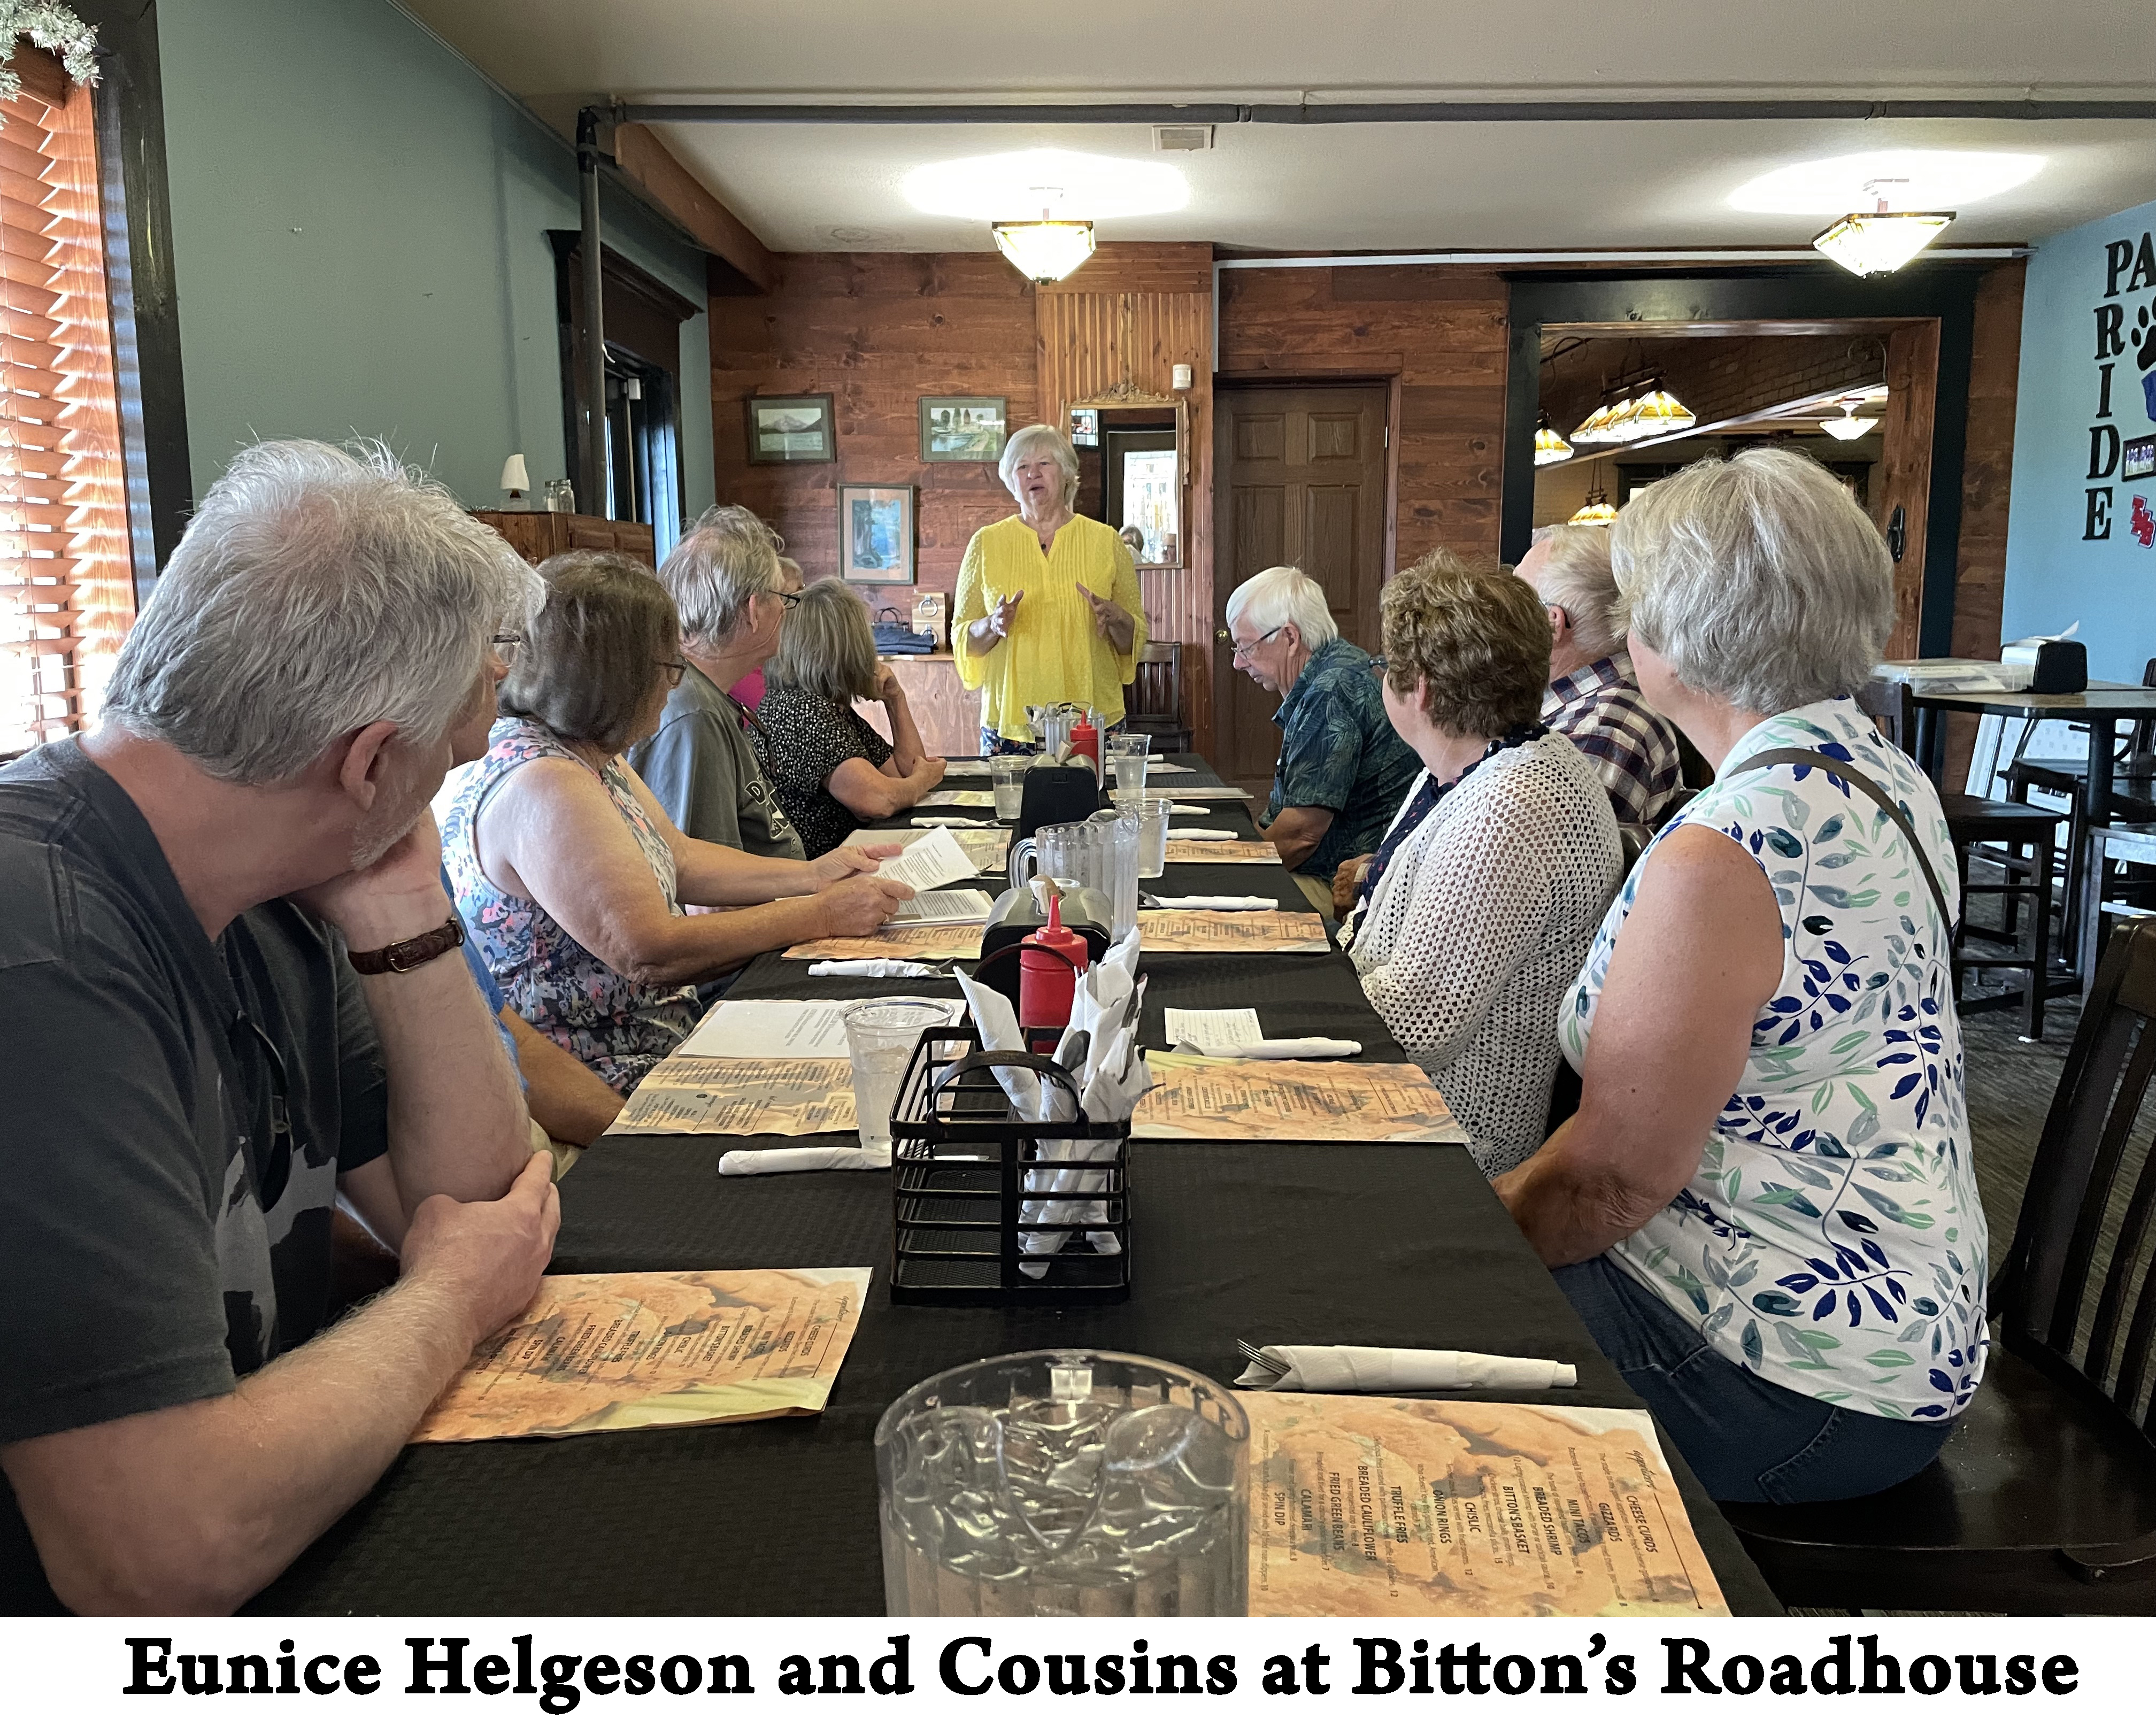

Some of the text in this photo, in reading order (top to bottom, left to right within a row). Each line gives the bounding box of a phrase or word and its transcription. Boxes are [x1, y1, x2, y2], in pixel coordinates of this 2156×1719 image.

[581, 1325, 596, 1339] FRIED
[602, 1319, 622, 1342] BREADED
[1274, 1492, 1285, 1525] SPIN DIP
[1300, 1489, 1313, 1531] CALAMARI
[1328, 1471, 1345, 1551] FRIED GREEN BEANS
[1358, 1466, 1377, 1561] BREADED CAULIFLOWER
[1390, 1486, 1408, 1544] TRUFFLE FRIES
[1433, 1490, 1452, 1544] ONION RINGS
[1465, 1502, 1481, 1533] CHISLIC
[1503, 1486, 1530, 1554] BITTON'S BASKET
[1533, 1487, 1562, 1555] BREADED SHRIMP
[1566, 1499, 1582, 1517] MINI
[1598, 1502, 1622, 1542] GIZZARDS
[1627, 1496, 1646, 1524] CHEESE
[1637, 1525, 1658, 1553] CURDS
[1572, 1518, 1590, 1543] TACOS
[1390, 1590, 1399, 1598] 12
